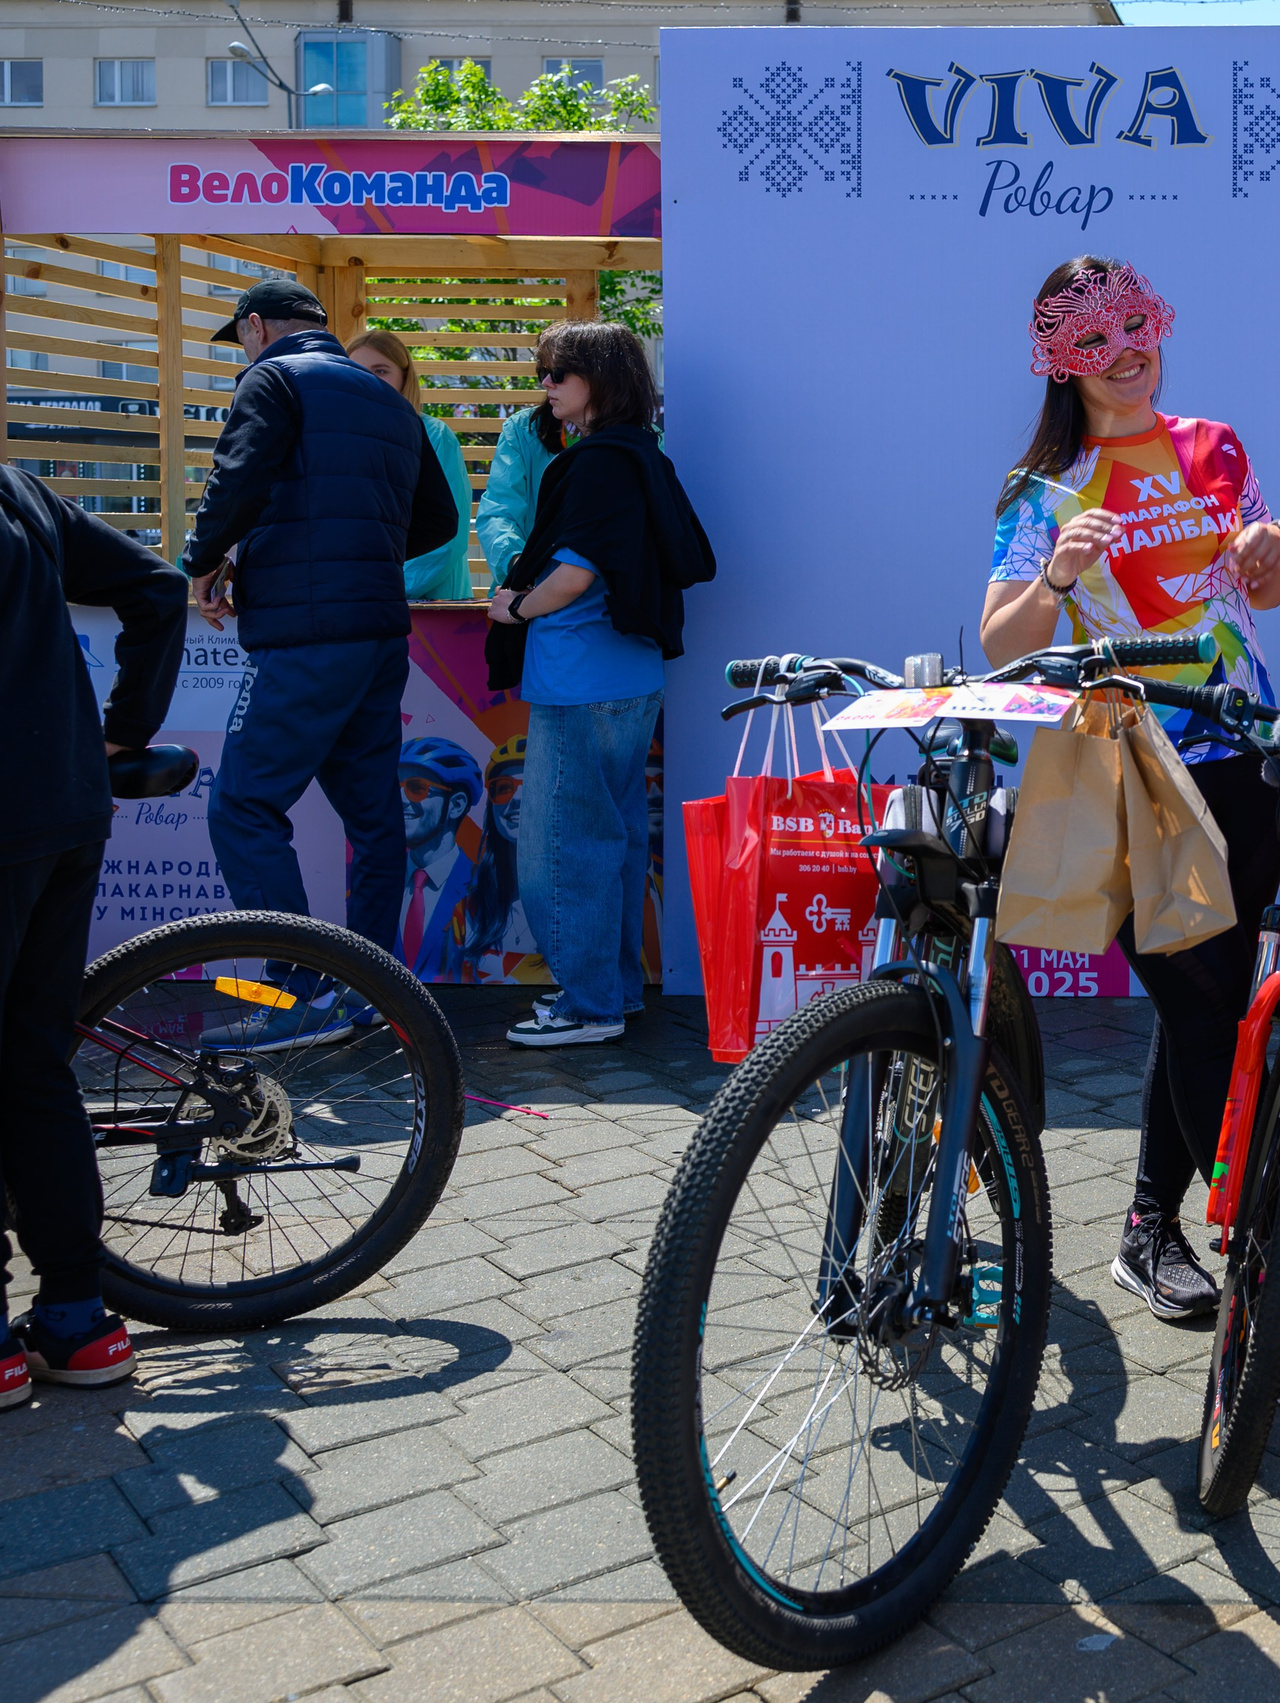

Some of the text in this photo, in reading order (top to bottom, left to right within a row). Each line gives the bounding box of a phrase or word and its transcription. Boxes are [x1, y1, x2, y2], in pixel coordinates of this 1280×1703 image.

[885, 61, 1214, 148] VIVA
[168, 163, 510, 212] ВелоКоманда
[978, 159, 1114, 230] Ровар
[1130, 471, 1180, 502] XV
[1120, 494, 1219, 525] МАРАФОН
[192, 677, 224, 689] 2009
[946, 801, 986, 827] STLLA
[948, 791, 988, 817] LTD
[135, 802, 188, 831] Ровар
[771, 815, 814, 832] BSB
[770, 848, 781, 856] Мы
[782, 849, 815, 857] работаем
[821, 850, 844, 859] душой
[799, 864, 811, 872] 306
[837, 865, 857, 874] bsb.by
[96, 883, 232, 899] ЛАКАРНАВ
[96, 906, 109, 921] У
[1041, 949, 1090, 969] МАЯ
[407, 1066, 427, 1174] OXTER
[108, 1337, 131, 1356] FILA
[4, 1363, 28, 1380] FILA
